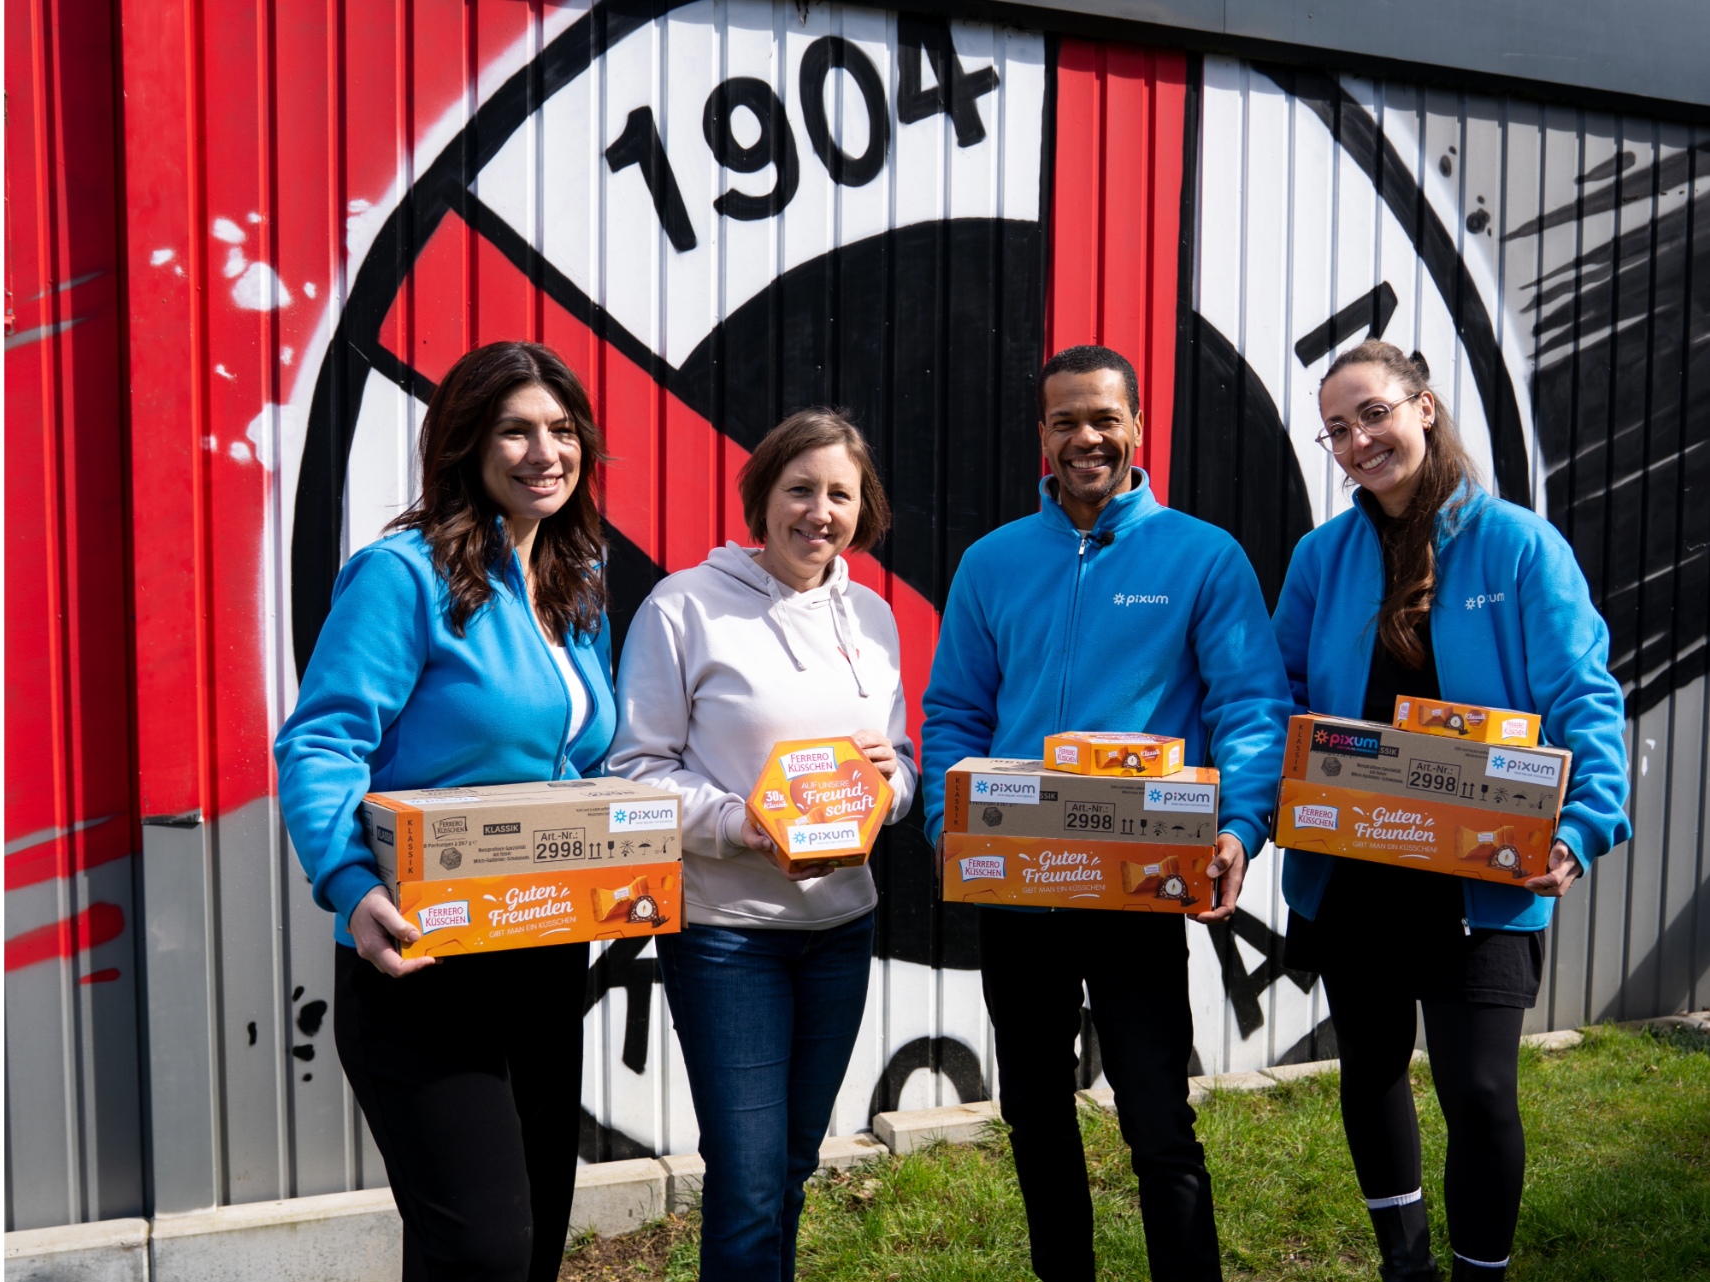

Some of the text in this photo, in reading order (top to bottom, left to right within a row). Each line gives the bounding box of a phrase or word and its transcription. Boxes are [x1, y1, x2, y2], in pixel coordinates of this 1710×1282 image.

[605, 14, 1000, 252] 1904
[1126, 594, 1169, 607] pixum
[1330, 732, 1379, 748] pixum
[1293, 724, 1304, 773] KLASSIK
[790, 753, 829, 763] FERRERO
[788, 762, 833, 772] KÜSSCHEN
[1416, 762, 1454, 775] Art.-Nr.:
[1506, 759, 1555, 776] pixum
[819, 780, 849, 788] UNSERE
[990, 782, 1035, 796] pixum
[1410, 772, 1456, 793] 2998
[803, 782, 869, 804] Freund-
[1164, 792, 1210, 804] pixum
[826, 795, 875, 816] schaft
[1072, 803, 1108, 813] Art.-Nr.:
[1302, 806, 1333, 818] FERRERO
[629, 807, 673, 825] pixum
[1066, 812, 1112, 830] 2998
[1298, 815, 1334, 828] KÜSSCHEN
[1372, 806, 1422, 825] Guten
[540, 830, 578, 841] Art.-Nr.:
[809, 829, 855, 845] pixum
[1354, 822, 1435, 843] Freunden
[536, 841, 583, 860] 2998
[1399, 842, 1438, 854] KÜSSCHEN!
[968, 858, 1000, 868] FERRERO
[1039, 851, 1088, 867] Guten
[965, 866, 1002, 878] KÜSSCHEN
[1022, 866, 1103, 884] Freunden
[505, 887, 556, 905] Guten
[1022, 886, 1036, 894] GIBT
[1069, 882, 1106, 892] KÜSSCHEN!
[428, 906, 464, 916] FERRERO
[488, 900, 573, 927] Freunden
[425, 914, 466, 927] KÜSSCHEN
[489, 917, 577, 938] GIBT MAN EIN KÜSSCHEN!
